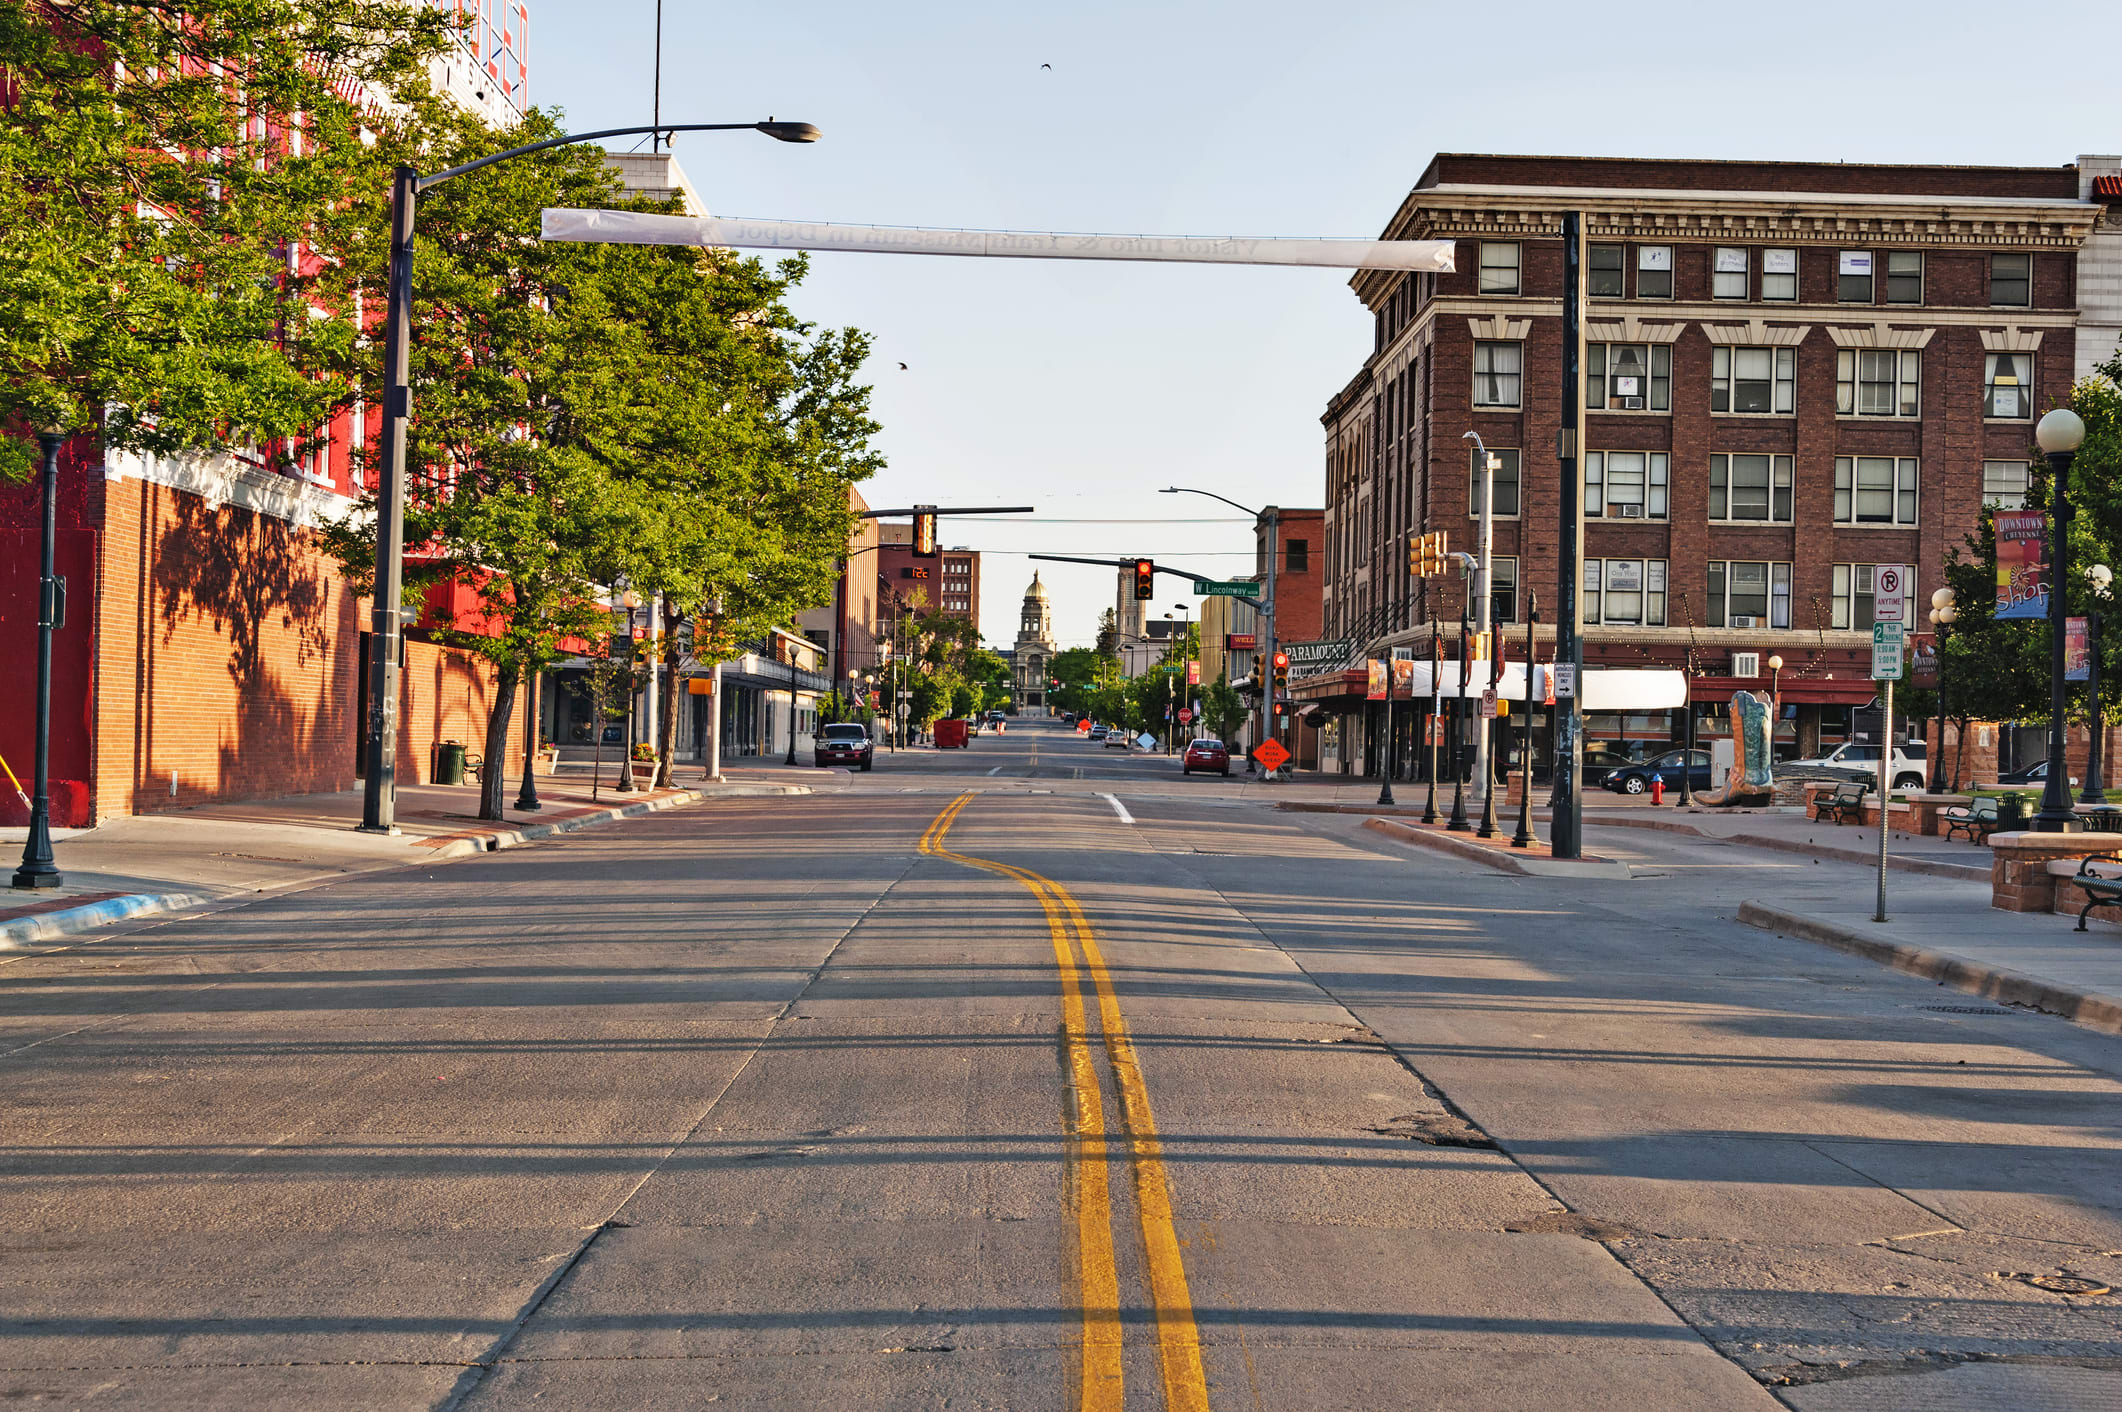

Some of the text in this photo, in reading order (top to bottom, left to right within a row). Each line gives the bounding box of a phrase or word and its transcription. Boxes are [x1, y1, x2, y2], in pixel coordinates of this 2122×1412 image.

[1998, 517, 2043, 532] DOWNTOWN
[2005, 530, 2041, 540] CHEYENNE
[1195, 582, 1247, 597] W Lincolnway
[1877, 598, 1902, 606] ANYTIME
[1875, 626, 1883, 641] 2
[1882, 633, 1902, 641] PARKING
[1285, 643, 1348, 662] PARAMOUNT
[1179, 710, 1191, 718] STOP
